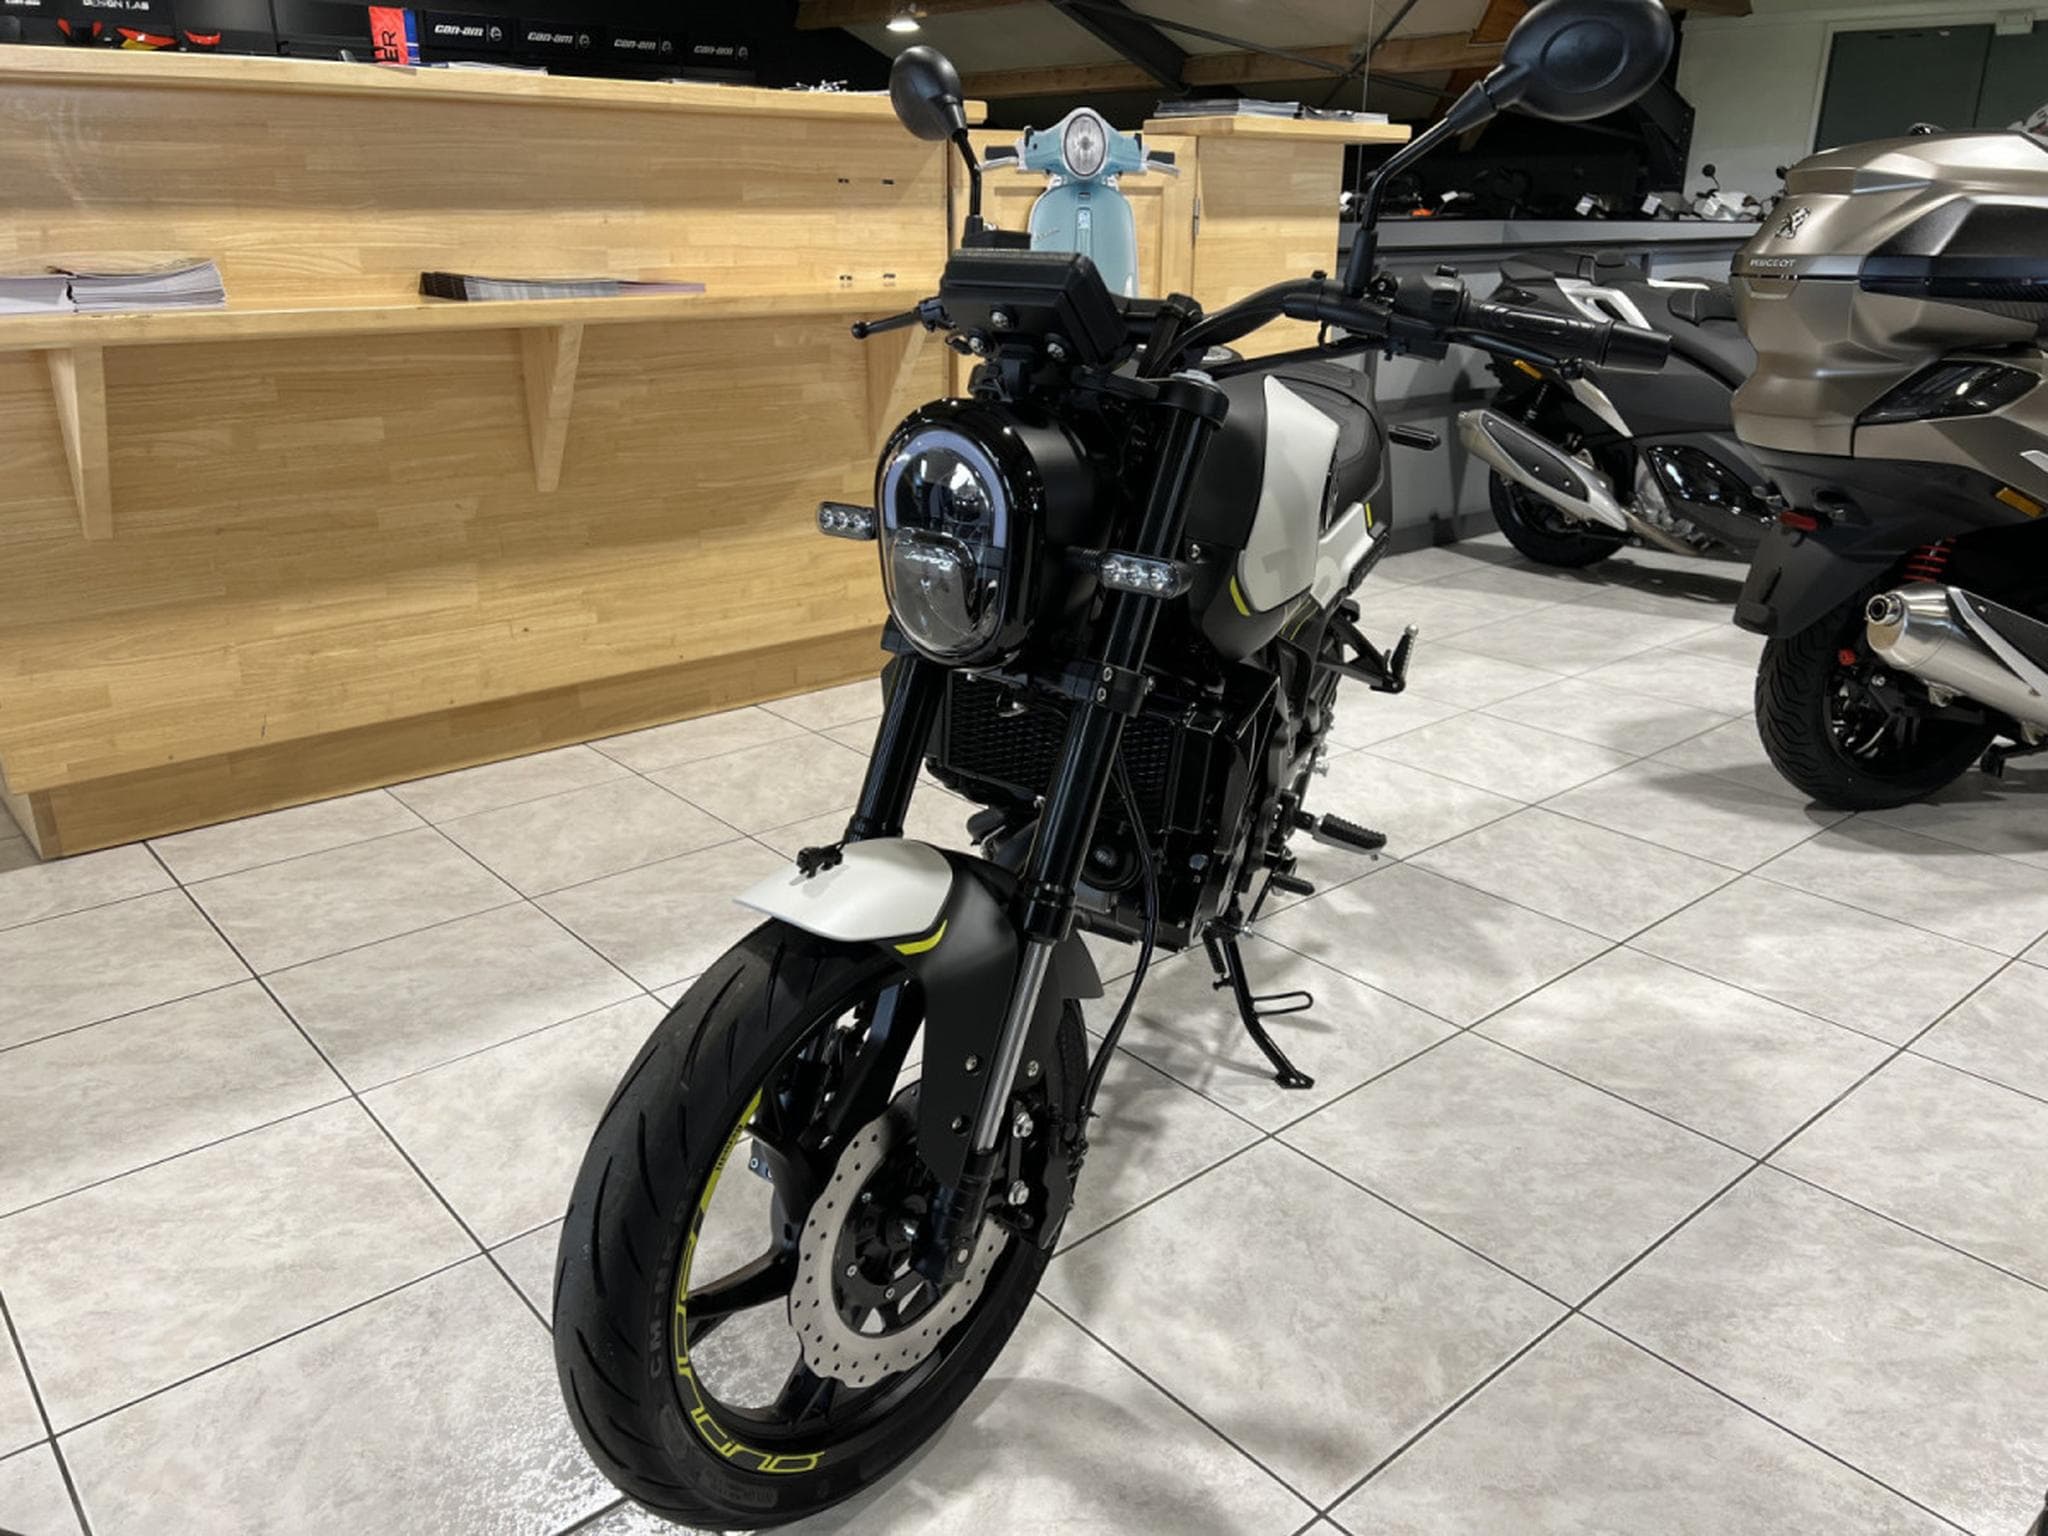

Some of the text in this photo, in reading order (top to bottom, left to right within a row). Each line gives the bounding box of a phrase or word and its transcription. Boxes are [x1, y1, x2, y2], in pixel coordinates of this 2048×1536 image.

[434, 24, 483, 36] can-am
[527, 31, 573, 44] can-am
[1749, 258, 1796, 268] PEUGEOT
